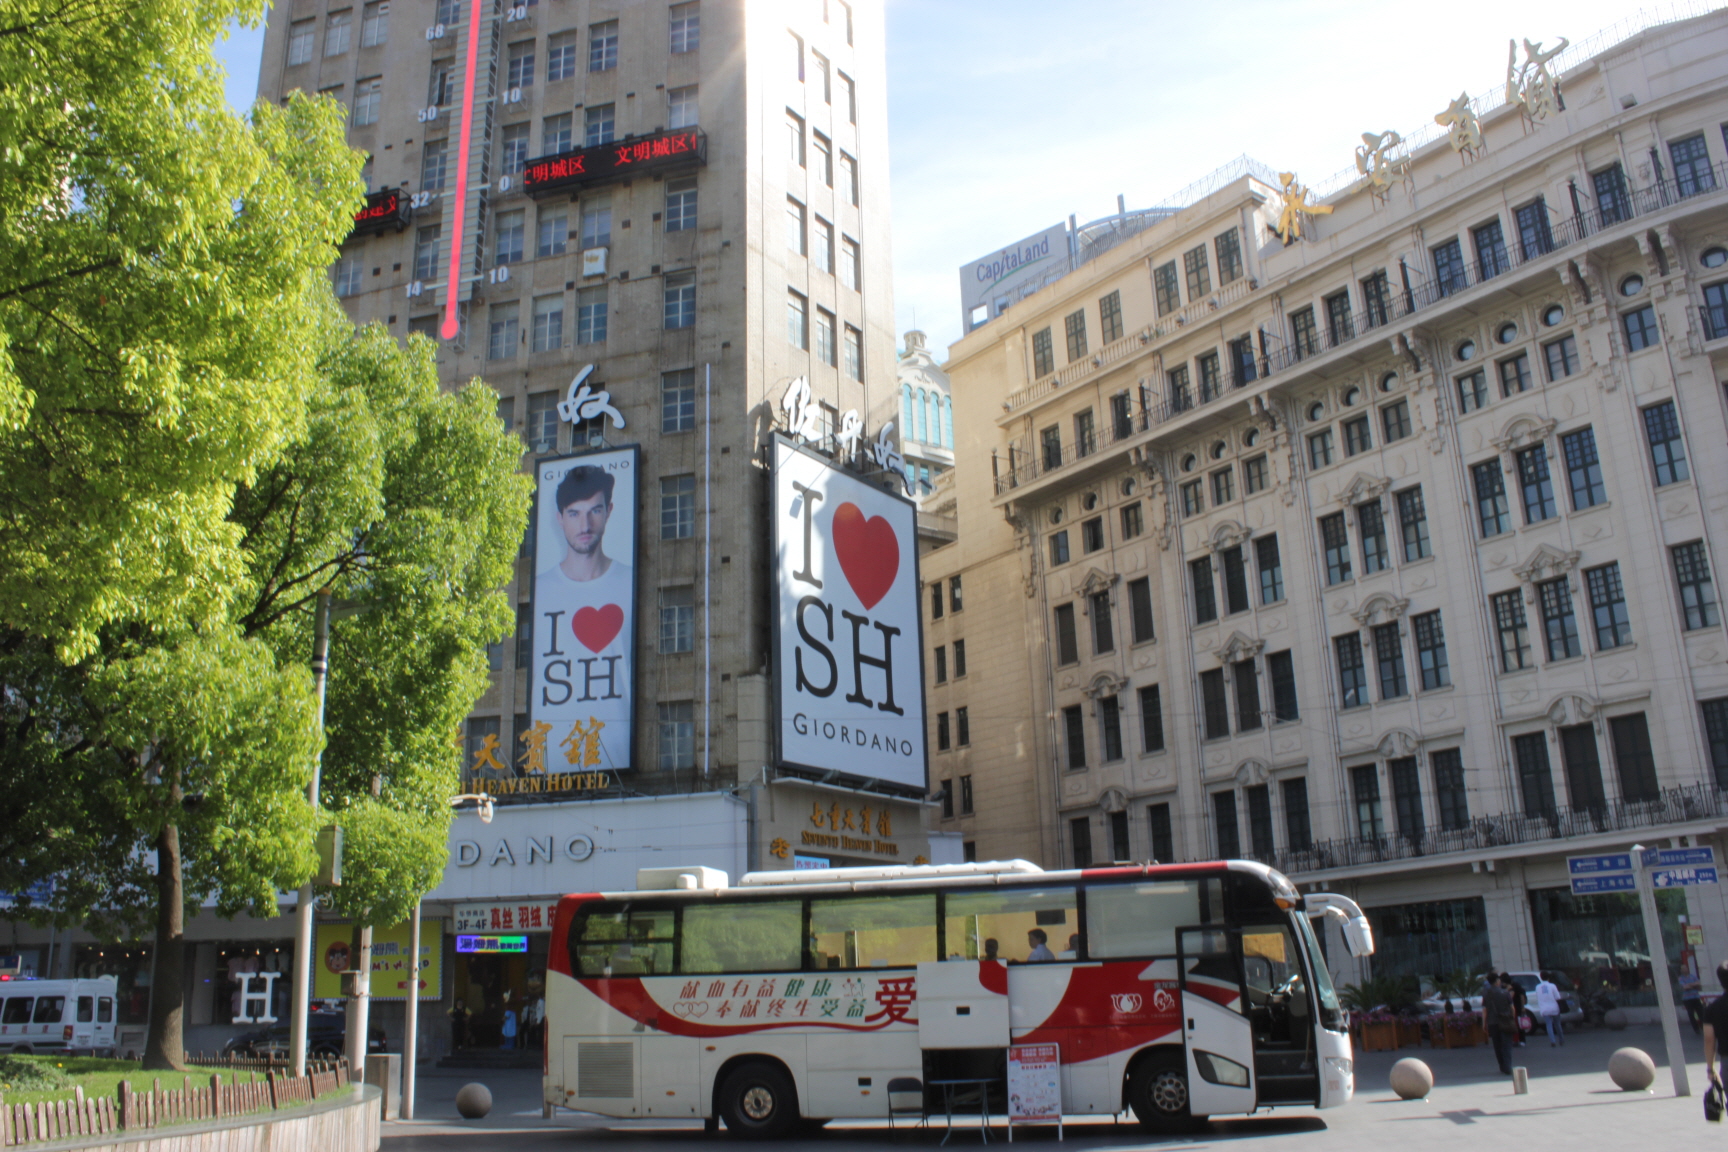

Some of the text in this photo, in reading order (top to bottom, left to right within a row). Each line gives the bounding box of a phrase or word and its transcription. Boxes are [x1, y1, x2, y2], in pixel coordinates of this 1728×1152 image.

[507, 5, 526, 22] 20
[425, 23, 445, 40] 68
[502, 87, 521, 105] 10
[418, 105, 437, 123] 50
[499, 175, 510, 192] 0
[410, 191, 430, 208] 32
[976, 235, 1049, 282] CapitaLand
[489, 266, 508, 284] 10
[405, 281, 422, 297] 14
[792, 480, 823, 590] I
[542, 610, 566, 657] I
[795, 595, 905, 717] SH
[542, 655, 622, 706] SH
[793, 713, 913, 764] GIORDANO
[472, 776, 542, 796] HEAVEN
[546, 772, 609, 793] HOTEL
[457, 919, 487, 931] 3F-4F
[680, 978, 832, 999] 献血有益健康
[866, 976, 919, 1025] 爱
